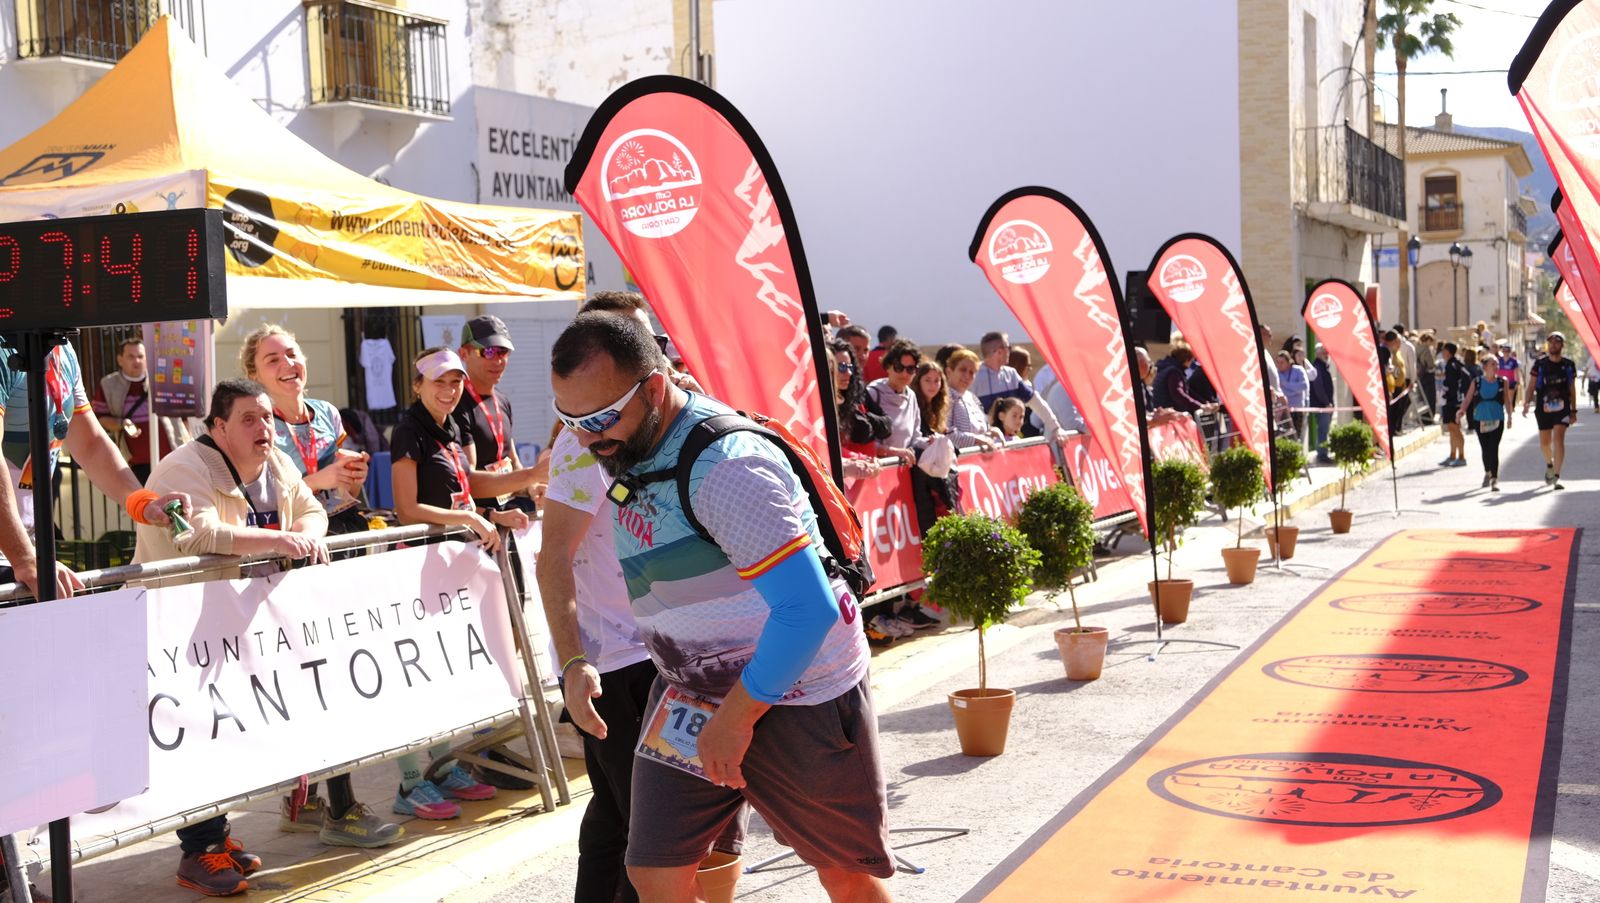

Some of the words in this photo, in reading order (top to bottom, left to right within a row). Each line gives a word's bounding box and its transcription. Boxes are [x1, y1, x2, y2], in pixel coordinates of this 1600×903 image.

[489, 127, 578, 163] EXCELENTÍ
[493, 172, 579, 205] AYUNTAM
[231, 212, 250, 223] uno
[617, 505, 654, 549] VIDA
[439, 587, 472, 615] DE
[149, 623, 493, 751] CANTORIA
[1251, 717, 1473, 732] Ayuntamiento
[1417, 716, 1456, 724] de
[1208, 762, 1395, 780] POLVORA
[1408, 769, 1459, 782] LA
[1148, 856, 1327, 877] Cantoria
[1342, 869, 1395, 882] de
[1111, 868, 1417, 899] Ayuntamiento
